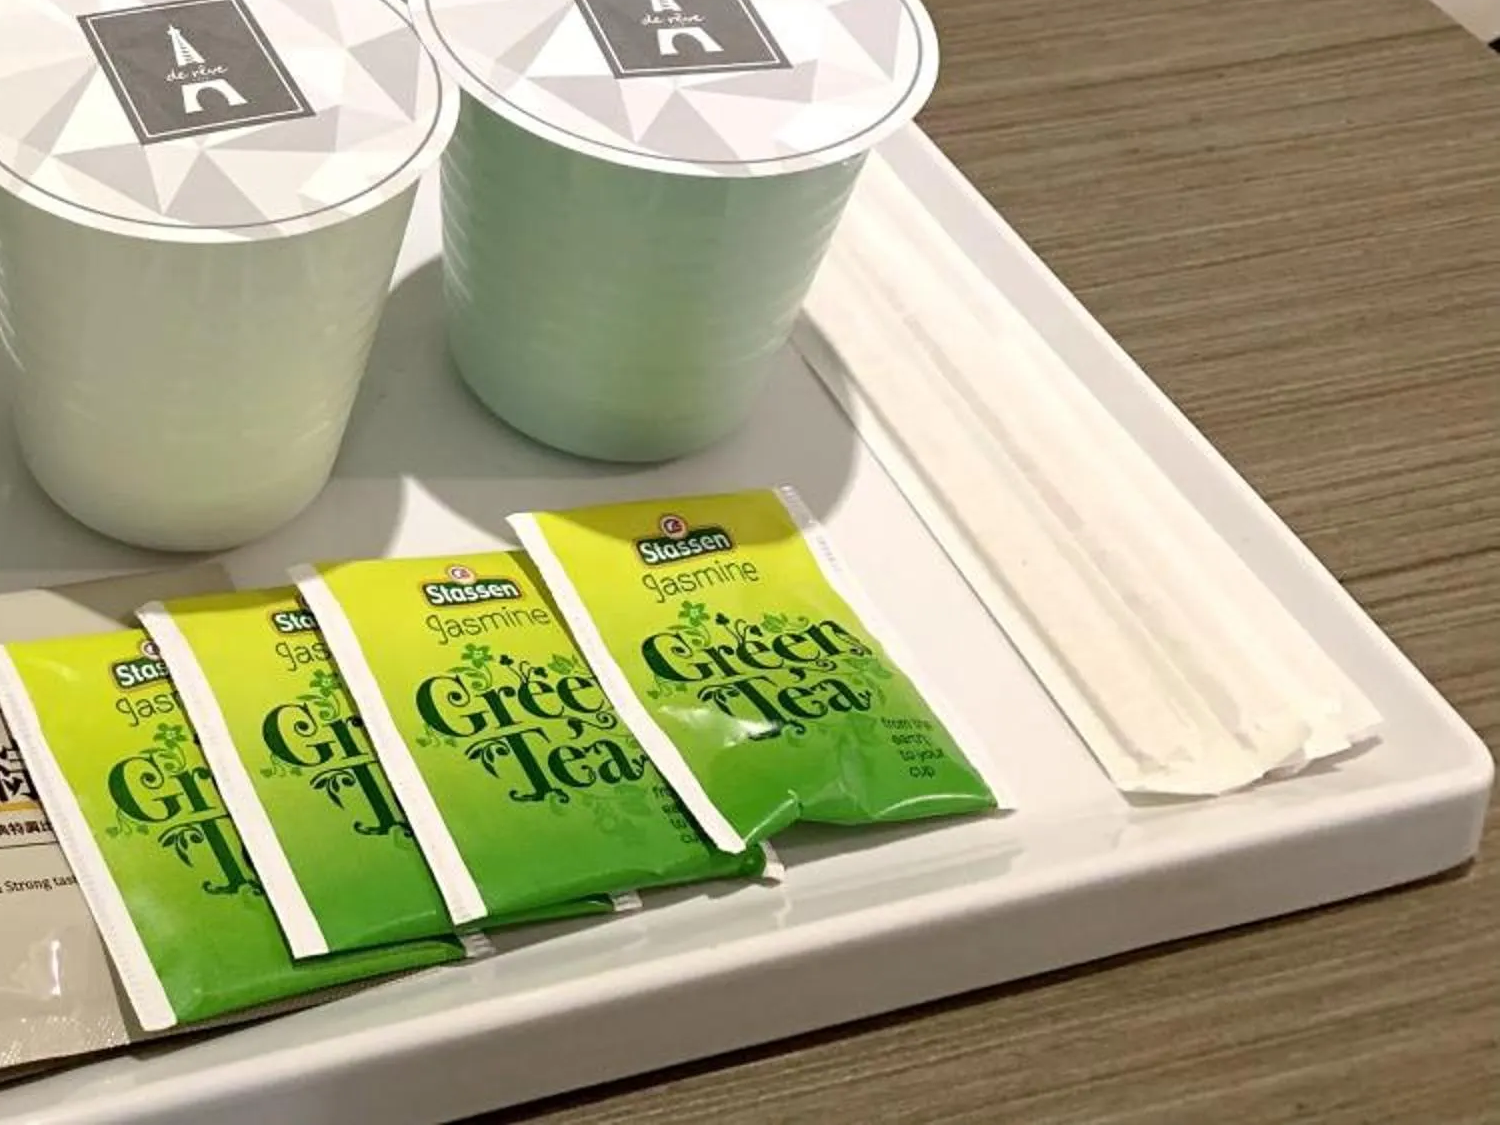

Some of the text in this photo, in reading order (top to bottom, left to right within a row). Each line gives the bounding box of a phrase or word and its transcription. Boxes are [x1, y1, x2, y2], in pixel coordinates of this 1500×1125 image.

[639, 531, 731, 564] Stassen
[425, 581, 519, 606] Stassen
[641, 617, 872, 683] Green
[698, 675, 872, 741] Tea
[466, 727, 649, 803] Tea
[4, 877, 52, 893] Strong
